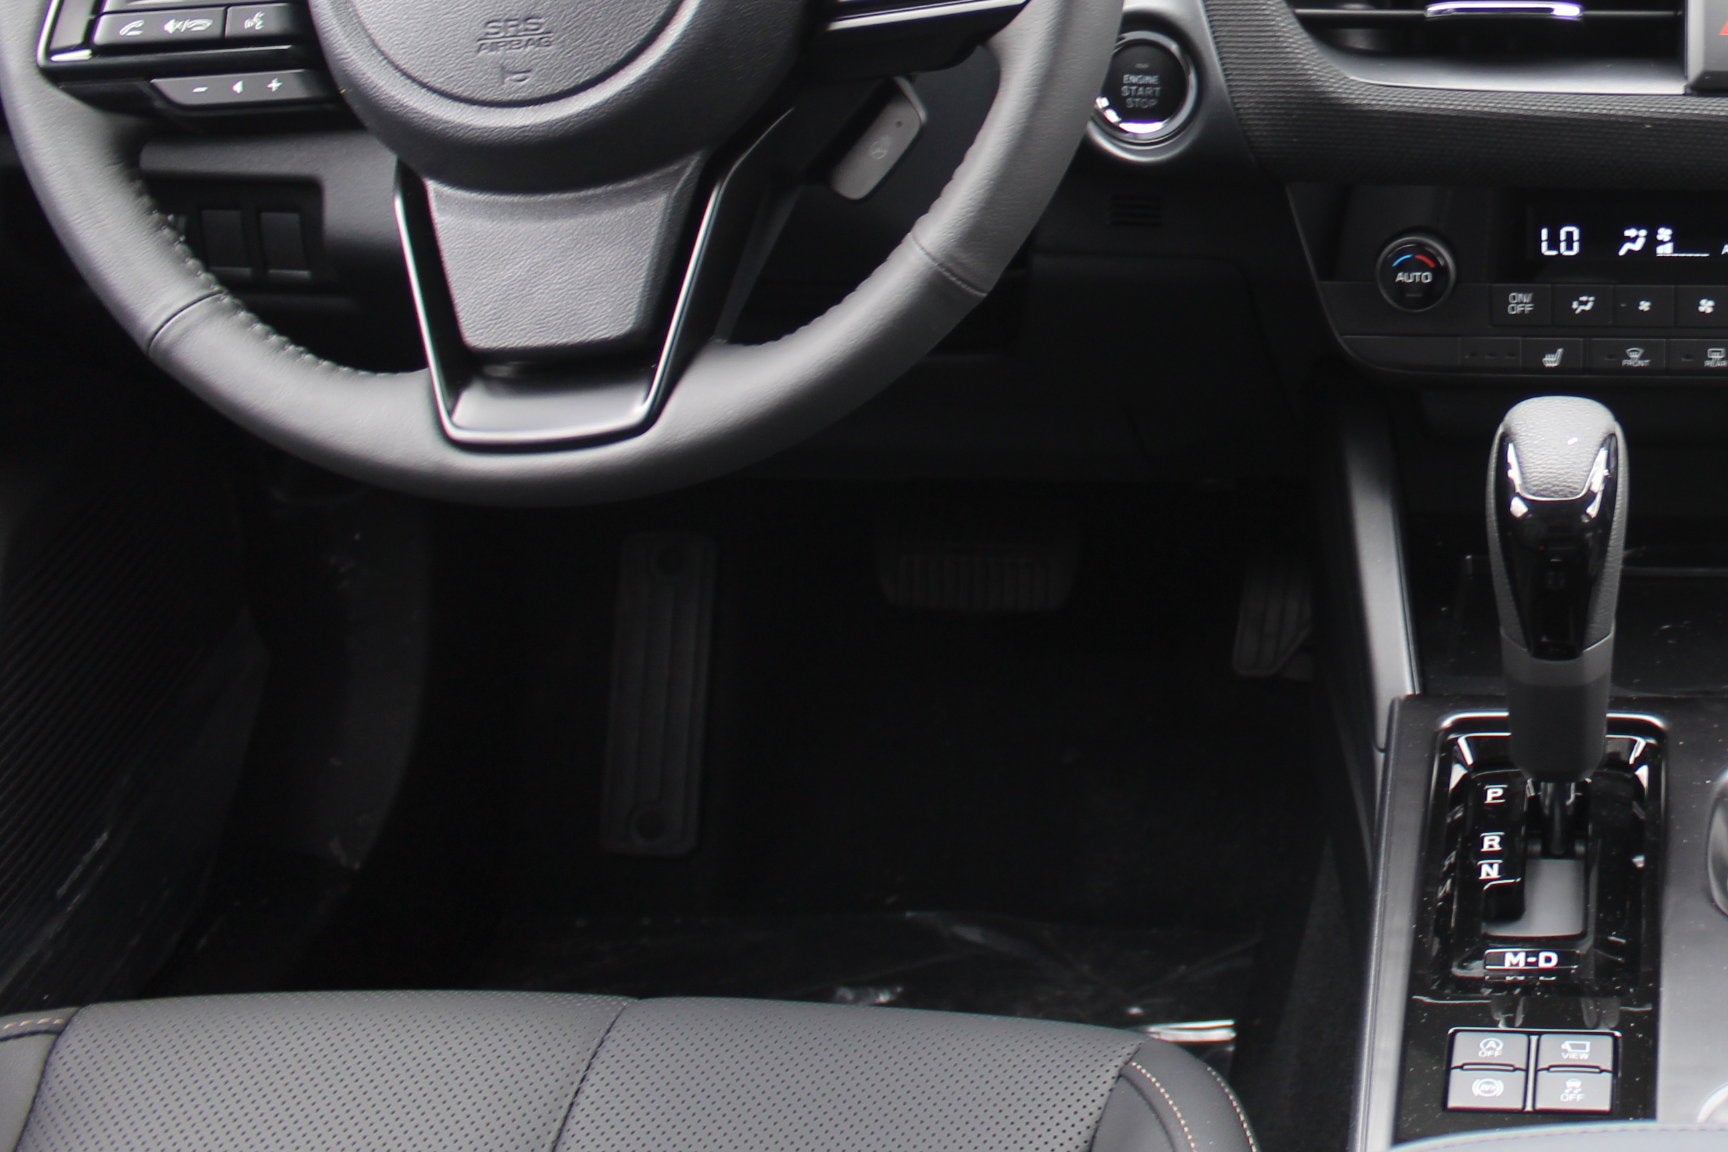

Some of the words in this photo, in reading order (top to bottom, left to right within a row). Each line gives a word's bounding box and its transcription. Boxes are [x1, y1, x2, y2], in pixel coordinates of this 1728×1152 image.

[1122, 74, 1160, 84] ENGINE
[1121, 85, 1161, 97] START
[1125, 97, 1158, 109] STOP
[1541, 226, 1580, 256] LO
[1395, 271, 1433, 284] AUTO
[1507, 304, 1535, 315] OFF
[1486, 787, 1504, 803] P
[1483, 835, 1502, 851] R
[1480, 863, 1500, 879] N
[1504, 951, 1558, 968] M-D
[1478, 1050, 1502, 1058] OFF
[1561, 1052, 1590, 1060] VIEW
[1560, 1093, 1585, 1102] OFF
